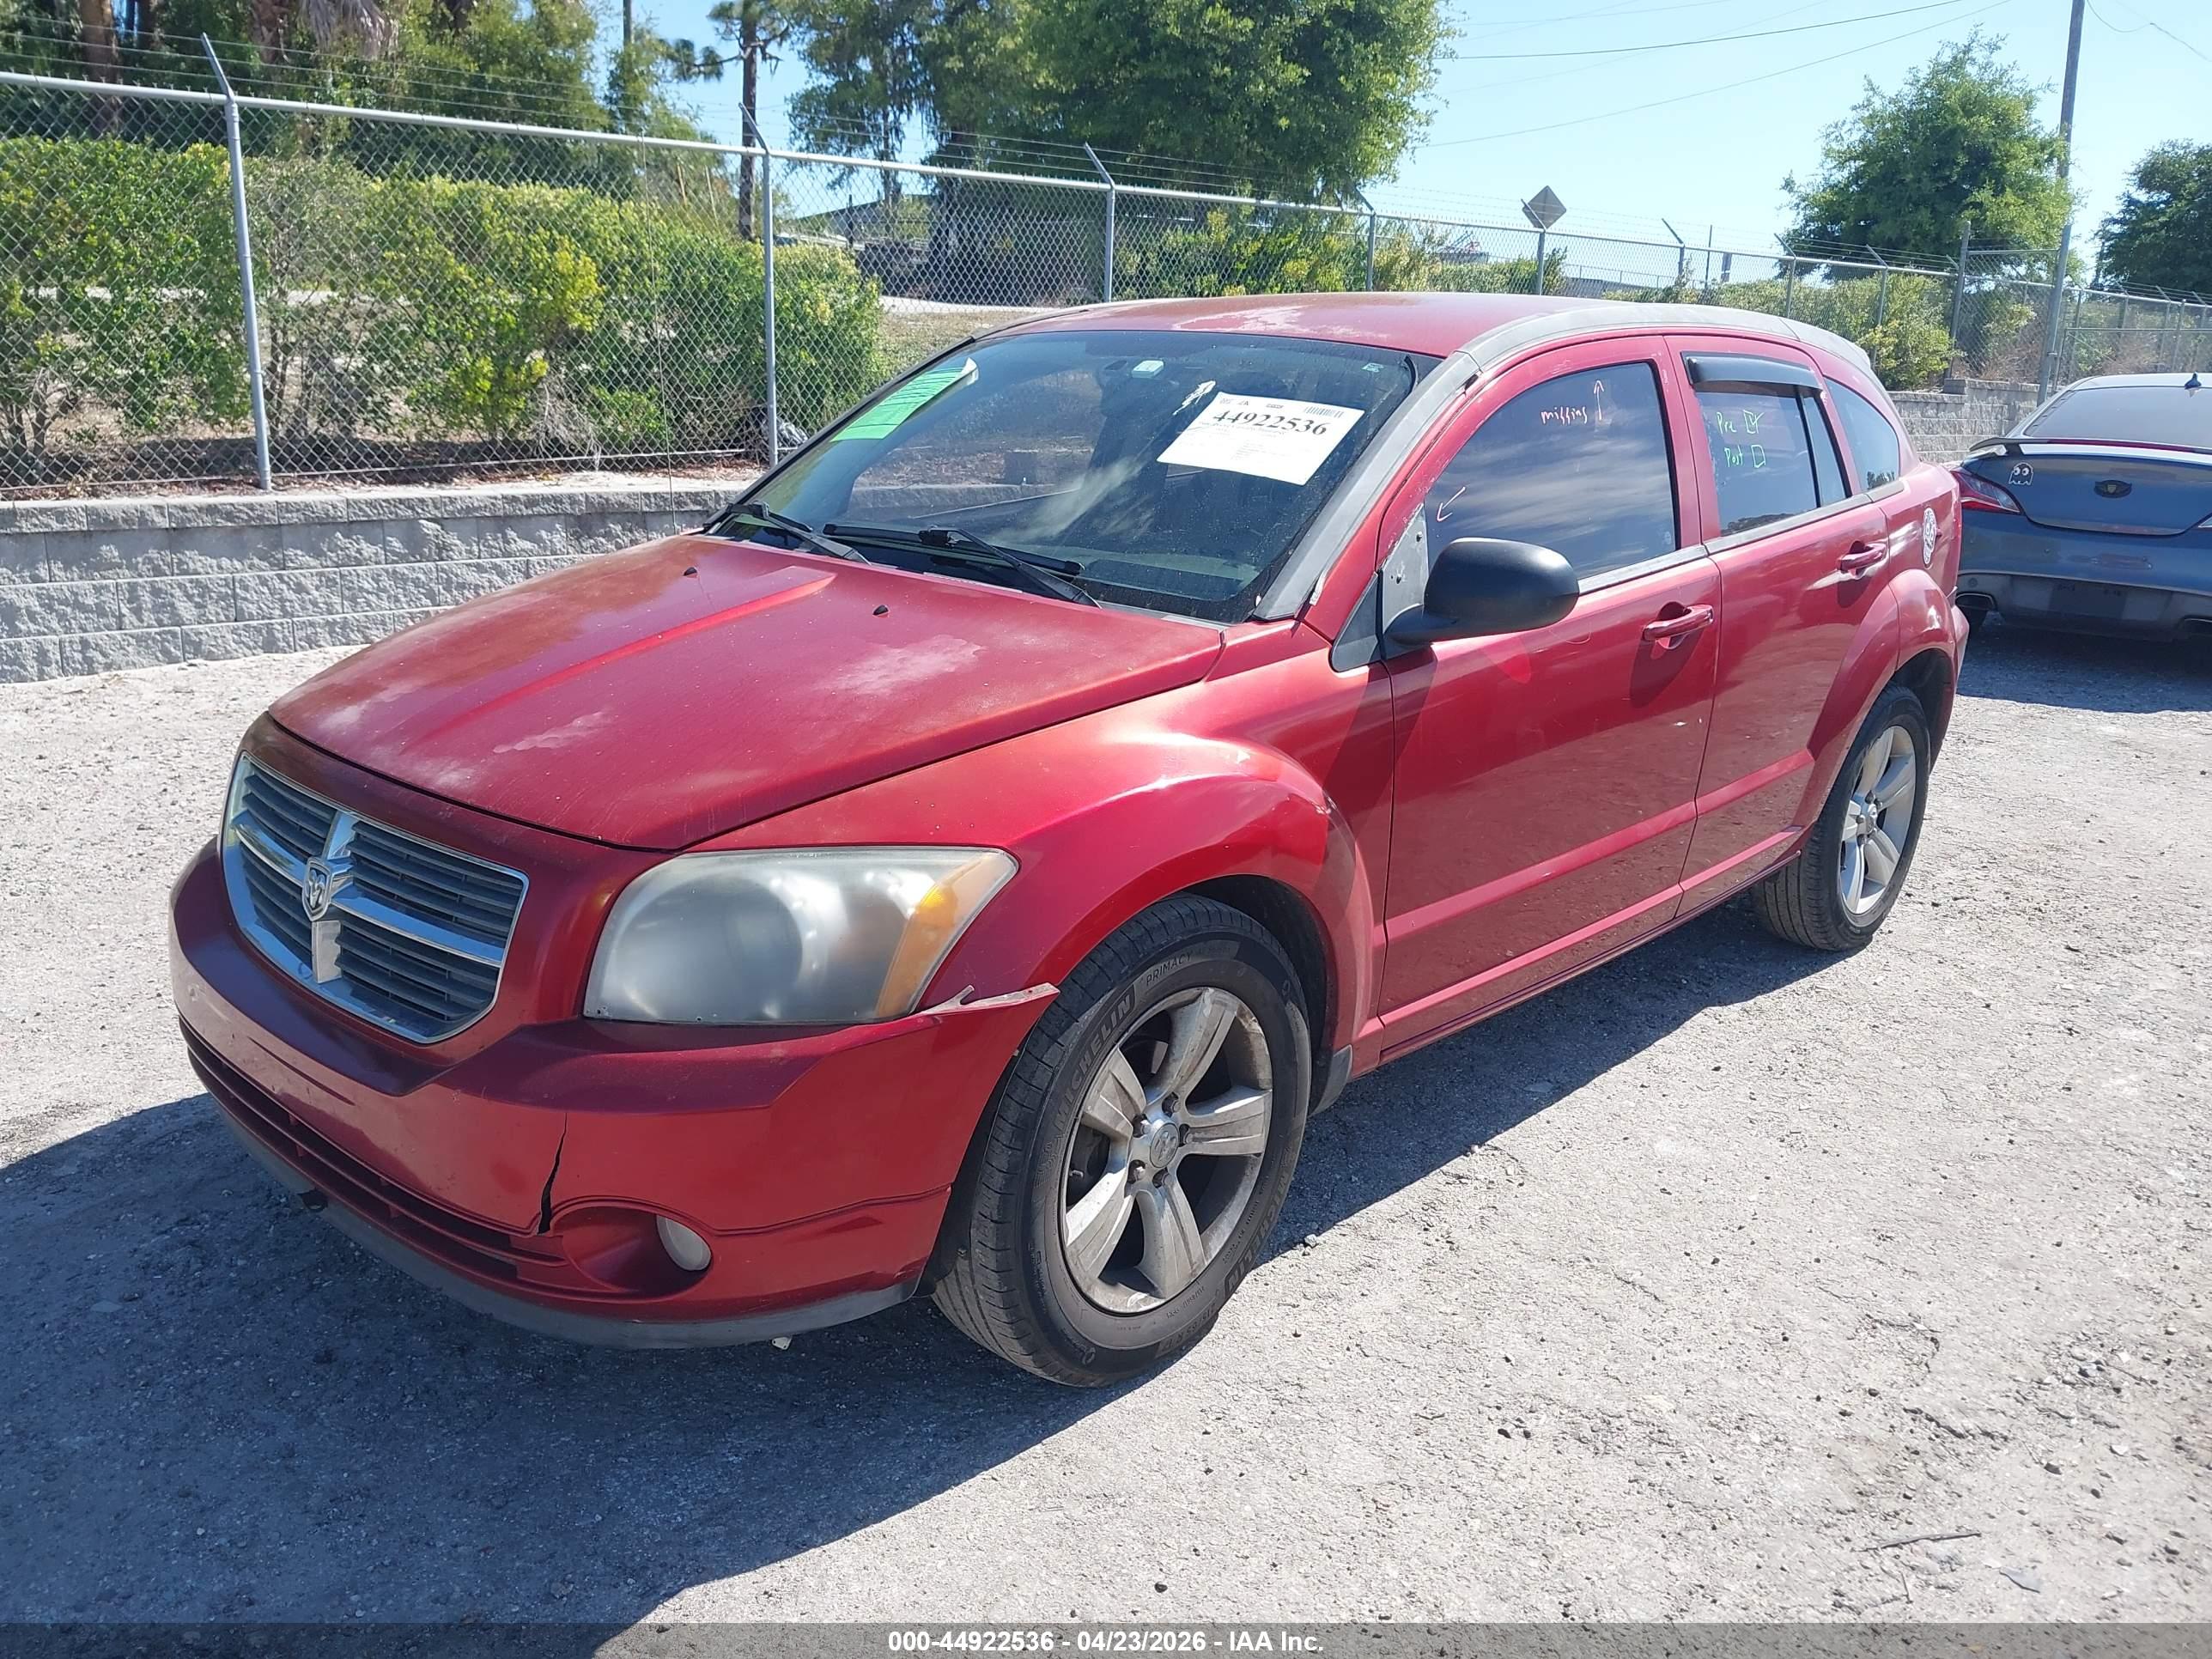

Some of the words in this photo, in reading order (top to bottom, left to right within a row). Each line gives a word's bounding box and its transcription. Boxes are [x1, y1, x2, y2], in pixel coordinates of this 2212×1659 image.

[1212, 410, 1331, 435] 44922536
[1716, 411, 1737, 434] Pre
[1723, 445, 1744, 467] Post
[1146, 951, 1192, 987] PRIMACY
[1053, 993, 1132, 1133] MICHELIN
